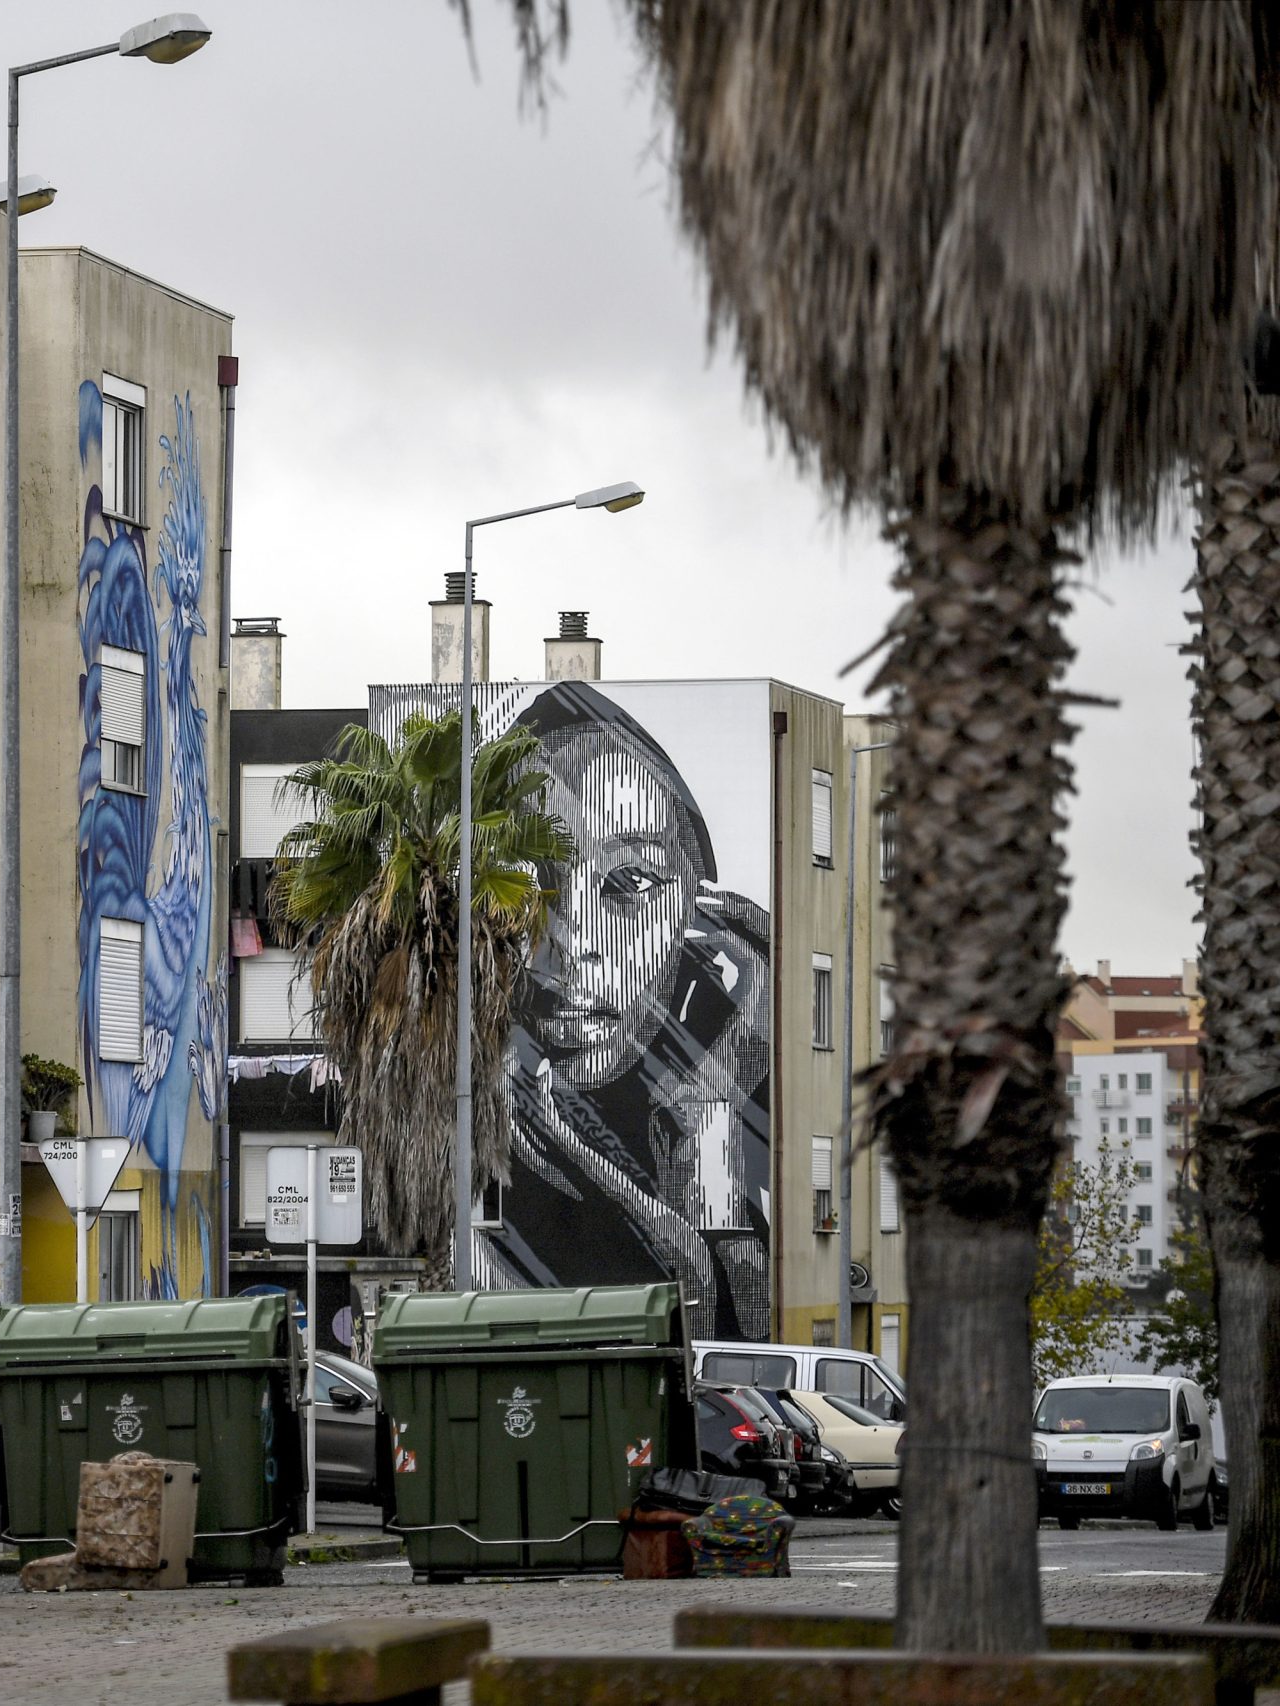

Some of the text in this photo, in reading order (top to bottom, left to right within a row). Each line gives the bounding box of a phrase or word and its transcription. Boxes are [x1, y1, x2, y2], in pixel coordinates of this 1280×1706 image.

[53, 1141, 74, 1150] CML
[43, 1152, 78, 1161] 724/200
[329, 1155, 356, 1166] MUDANÇAS
[277, 1186, 299, 1194] CML
[267, 1196, 309, 1204] 822/2004
